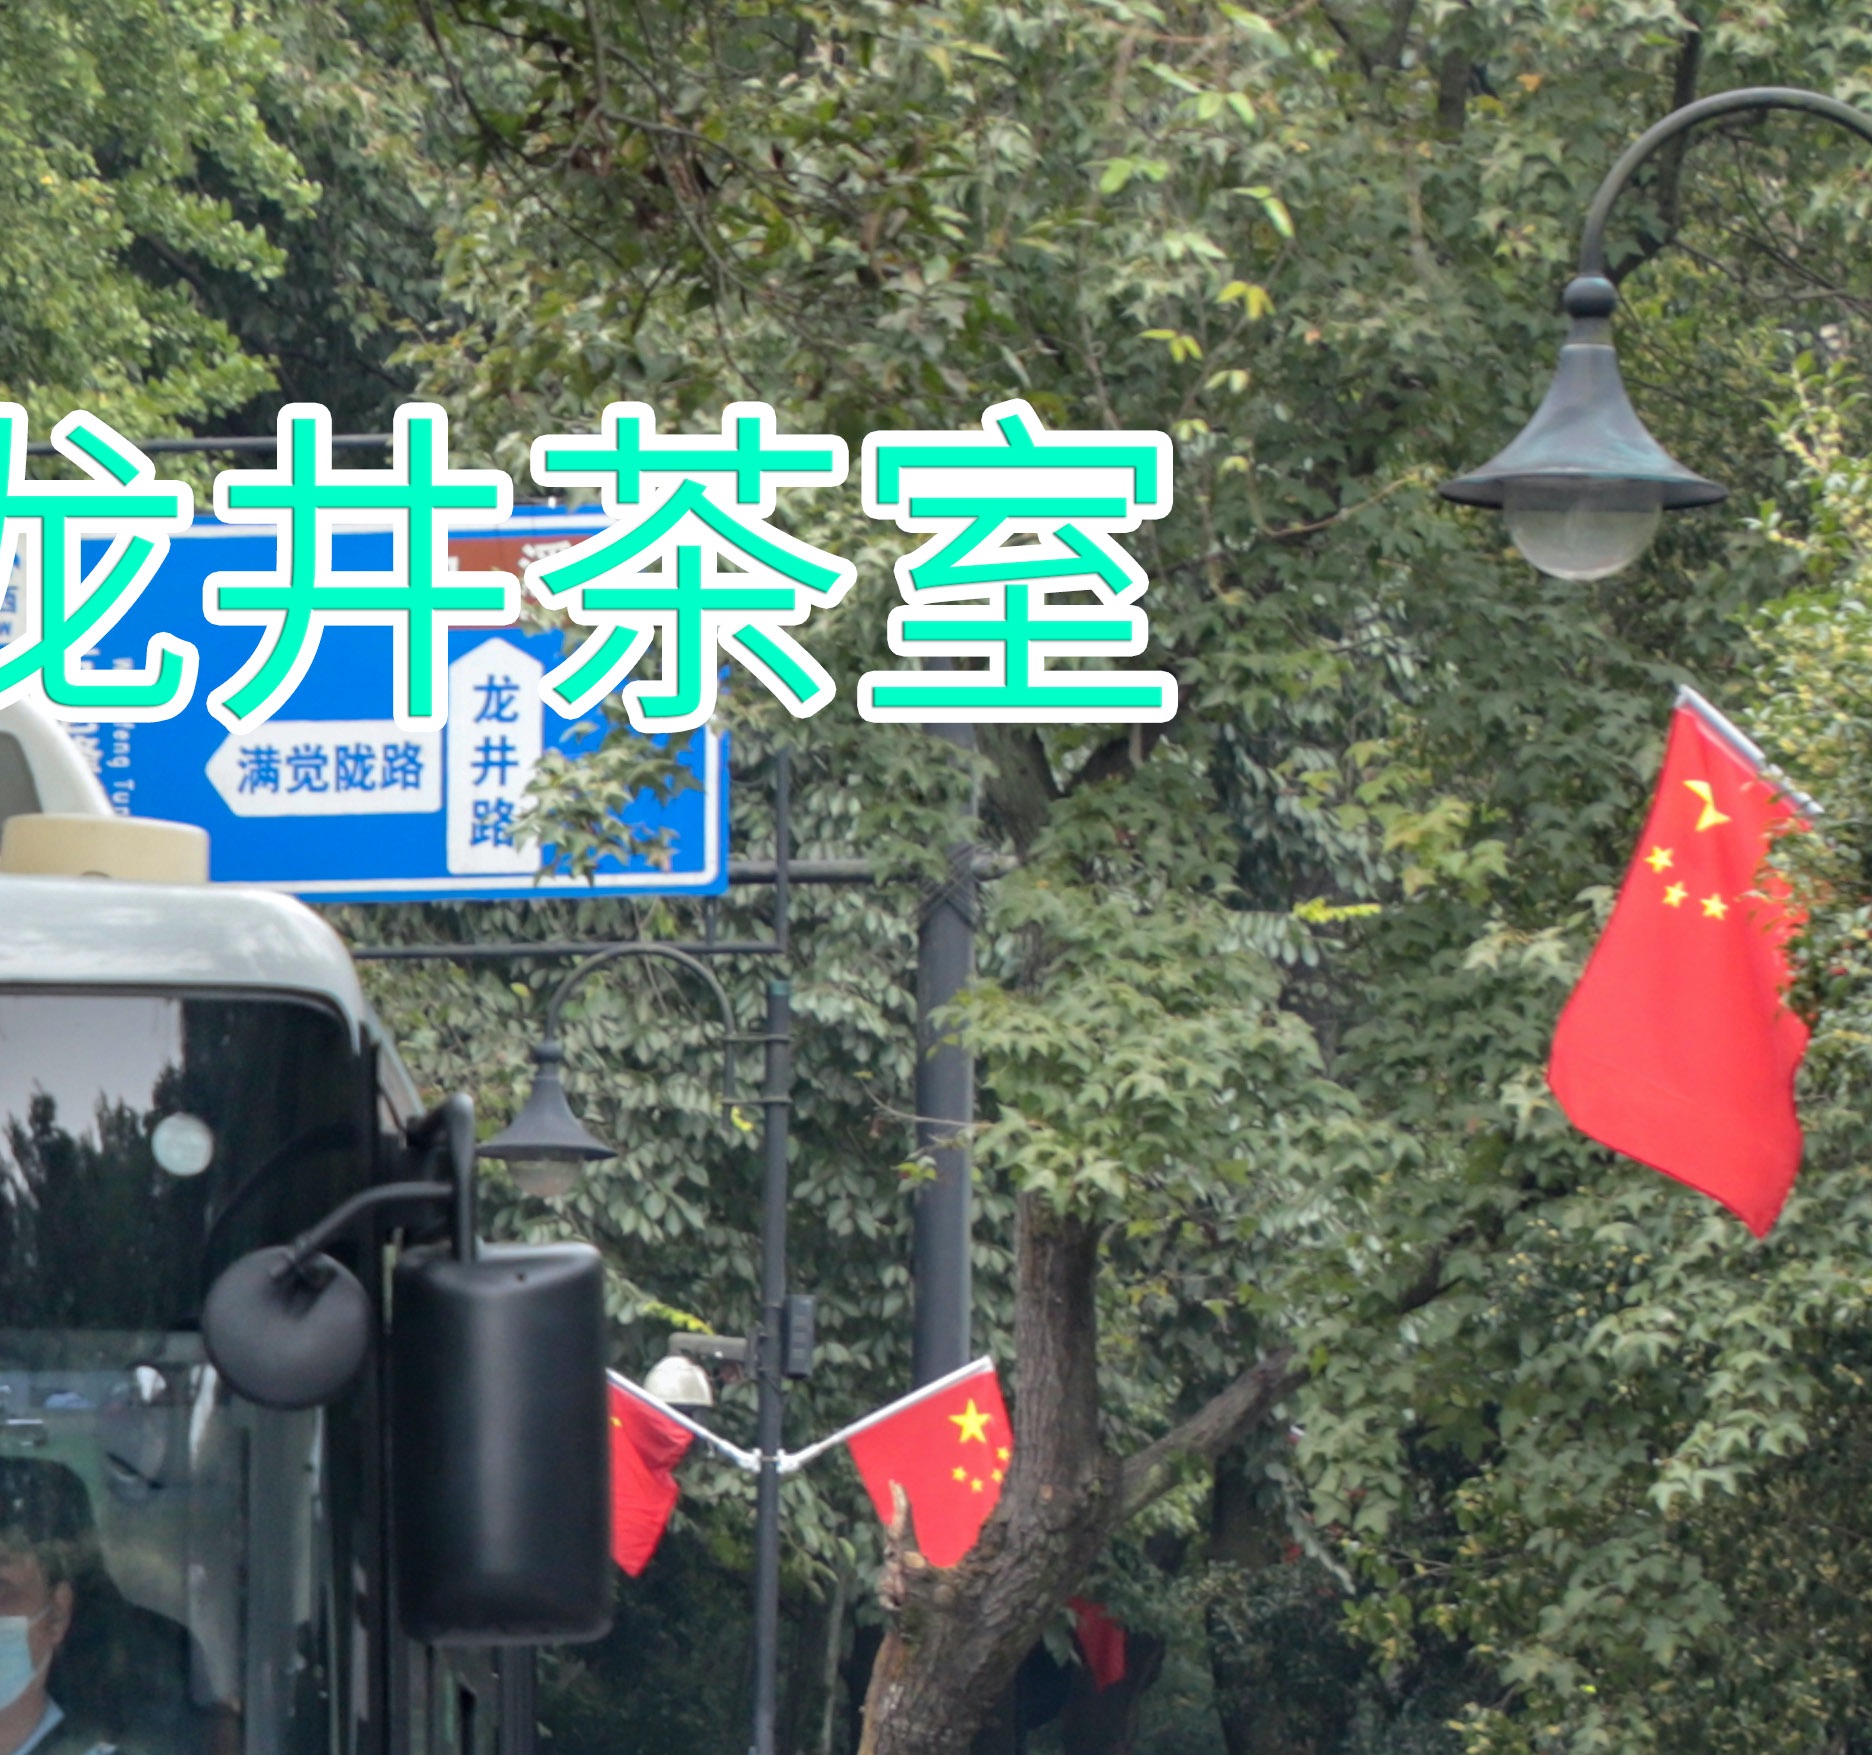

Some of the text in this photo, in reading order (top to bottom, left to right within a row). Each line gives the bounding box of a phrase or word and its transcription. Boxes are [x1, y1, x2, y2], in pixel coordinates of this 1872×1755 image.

[236, 741, 425, 796] 满觉陇路
[469, 674, 521, 848] 龙井路
